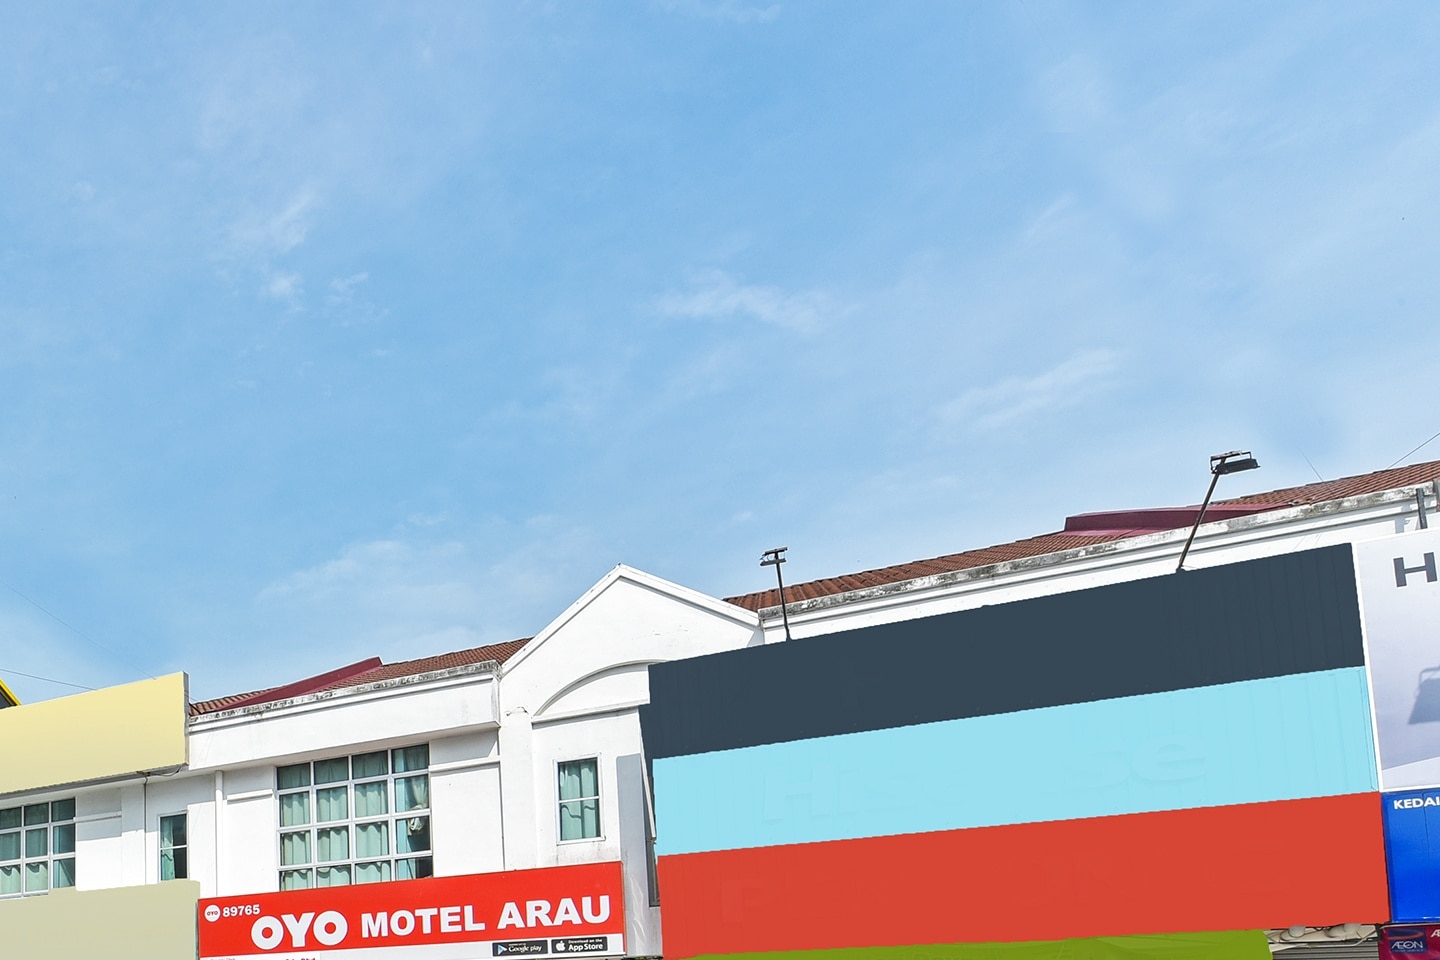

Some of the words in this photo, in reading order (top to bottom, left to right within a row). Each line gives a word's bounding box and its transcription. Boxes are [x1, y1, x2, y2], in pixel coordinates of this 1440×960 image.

[1393, 552, 1438, 588] H
[1393, 796, 1440, 810] KEDAI
[222, 904, 261, 918] 89765
[251, 910, 349, 950] OYO
[361, 905, 486, 939] MOTEL
[497, 895, 611, 930] ARAU
[508, 945, 530, 953] Google
[529, 944, 542, 952] play
[568, 944, 583, 952] App
[583, 943, 604, 951] Store
